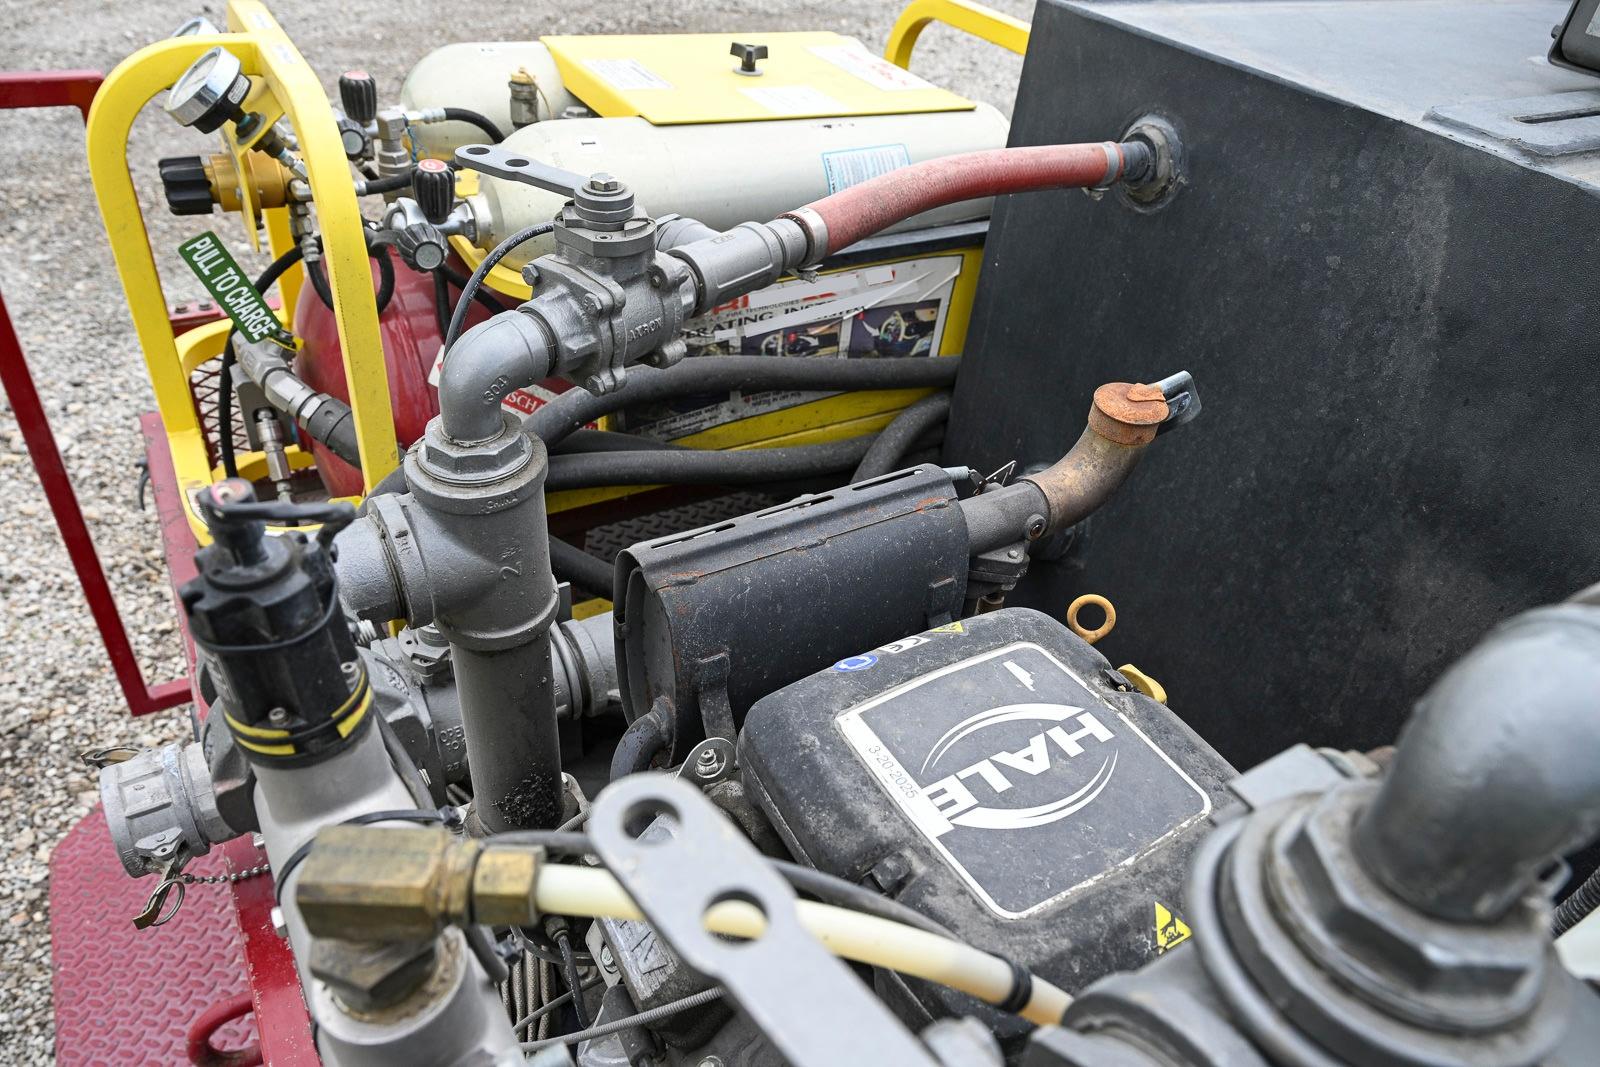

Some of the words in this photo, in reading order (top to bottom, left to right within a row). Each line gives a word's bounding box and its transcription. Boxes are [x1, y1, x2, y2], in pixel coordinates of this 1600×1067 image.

[185, 236, 225, 276] PULL
[211, 266, 240, 292] TO
[224, 286, 277, 340] CHARGE
[745, 299, 801, 314] TECHNOLOGIES
[868, 745, 918, 799] 3-20-2025
[921, 710, 1116, 820] HALE
